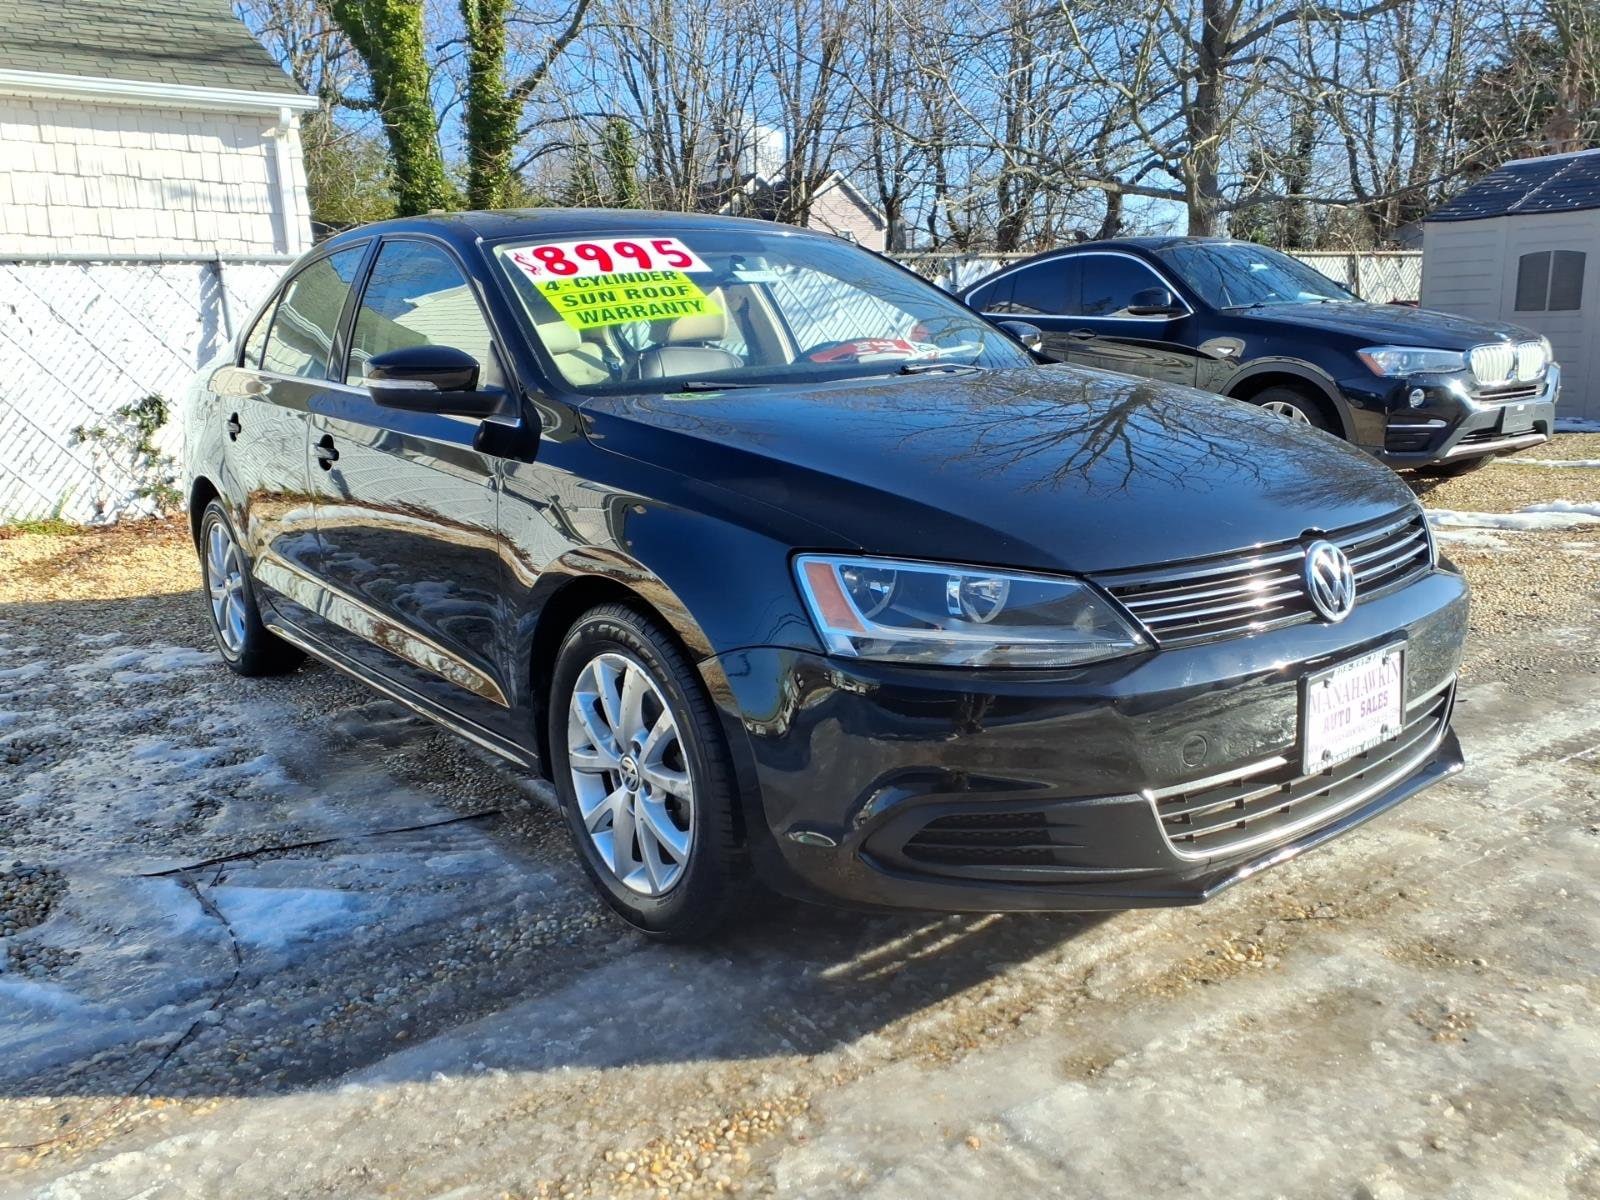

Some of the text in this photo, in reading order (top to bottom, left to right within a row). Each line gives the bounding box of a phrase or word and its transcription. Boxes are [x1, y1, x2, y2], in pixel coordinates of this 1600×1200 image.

[514, 240, 693, 276] $8995
[563, 285, 691, 308] SUN ROOF
[576, 300, 704, 325] WARRANTY
[1310, 660, 1399, 713] MANAHAWKIN
[1324, 707, 1351, 733] AUTO
[1360, 690, 1389, 718] SALES
